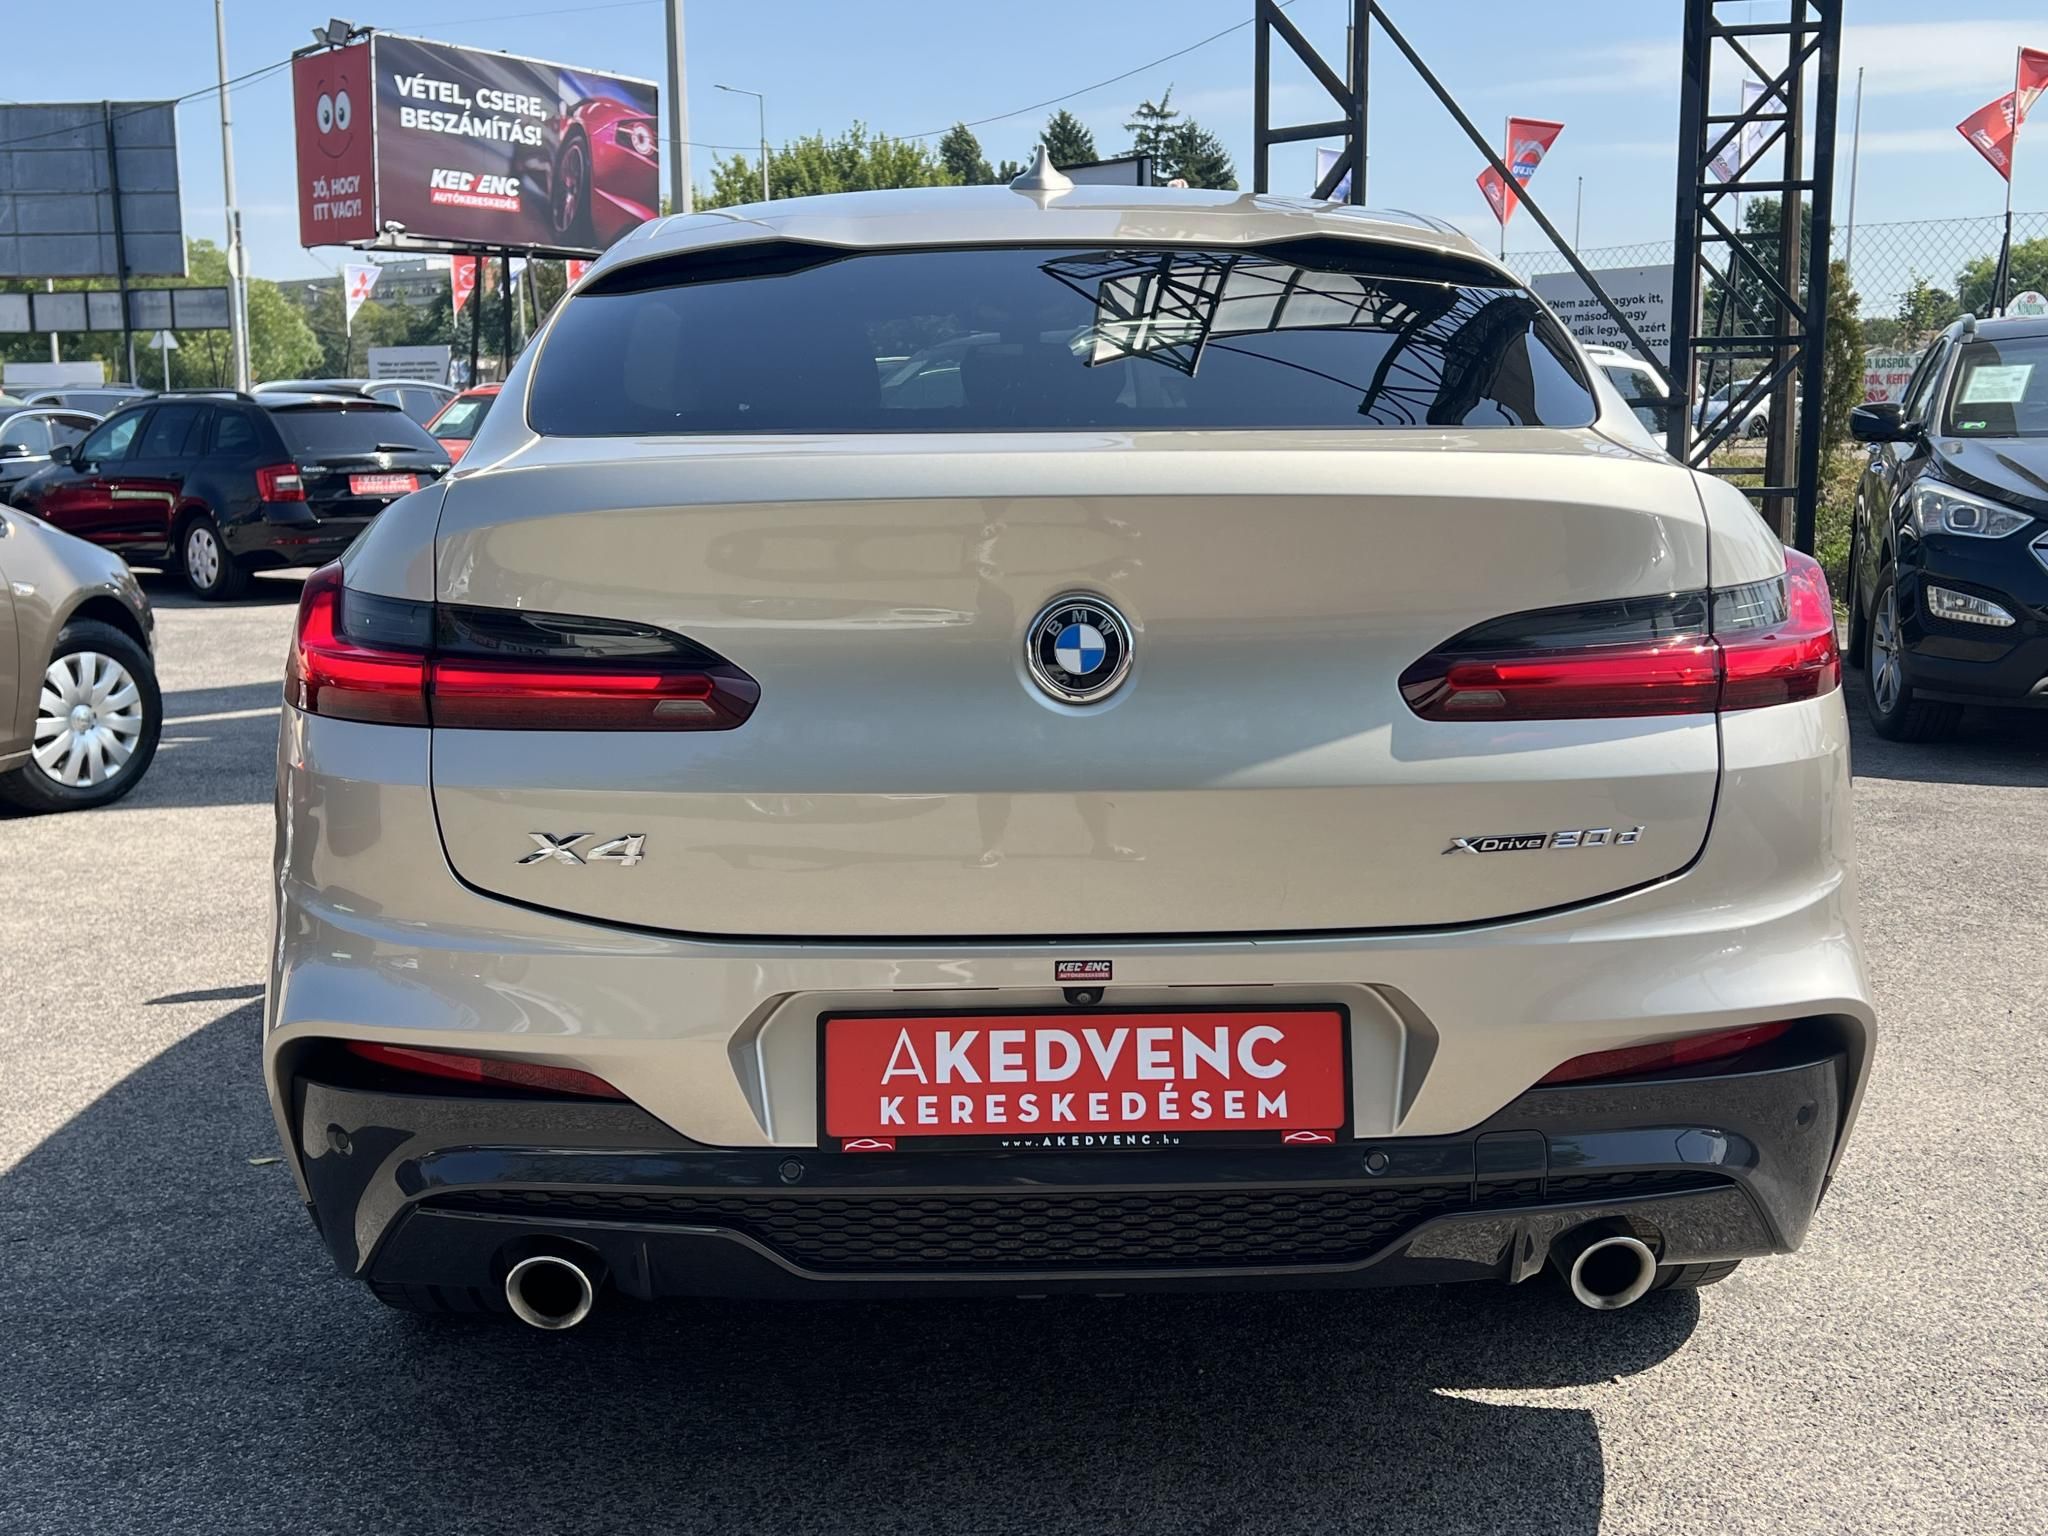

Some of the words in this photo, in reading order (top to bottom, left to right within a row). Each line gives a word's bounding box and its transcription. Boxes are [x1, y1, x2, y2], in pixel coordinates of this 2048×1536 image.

[394, 73, 472, 109] VÉTEL,
[476, 88, 548, 122] CSERE,
[400, 106, 543, 146] BESZÁMÍTÁS!
[313, 175, 330, 200] JÓ,
[331, 175, 361, 196] HOGY
[313, 203, 329, 221] ITT
[331, 199, 362, 219] VAGY!
[1578, 297, 1602, 307] azér
[1611, 294, 1645, 307] agyok
[1648, 292, 1664, 304] itt,
[1572, 325, 1594, 336] adik
[1638, 322, 1666, 332] azért
[1047, 610, 1114, 636] BMW
[514, 832, 647, 866] X4
[880, 1082, 1288, 1125] KERESKEDÉSEM
[1002, 1134, 1180, 1147] www.AKEDVENC.hu
